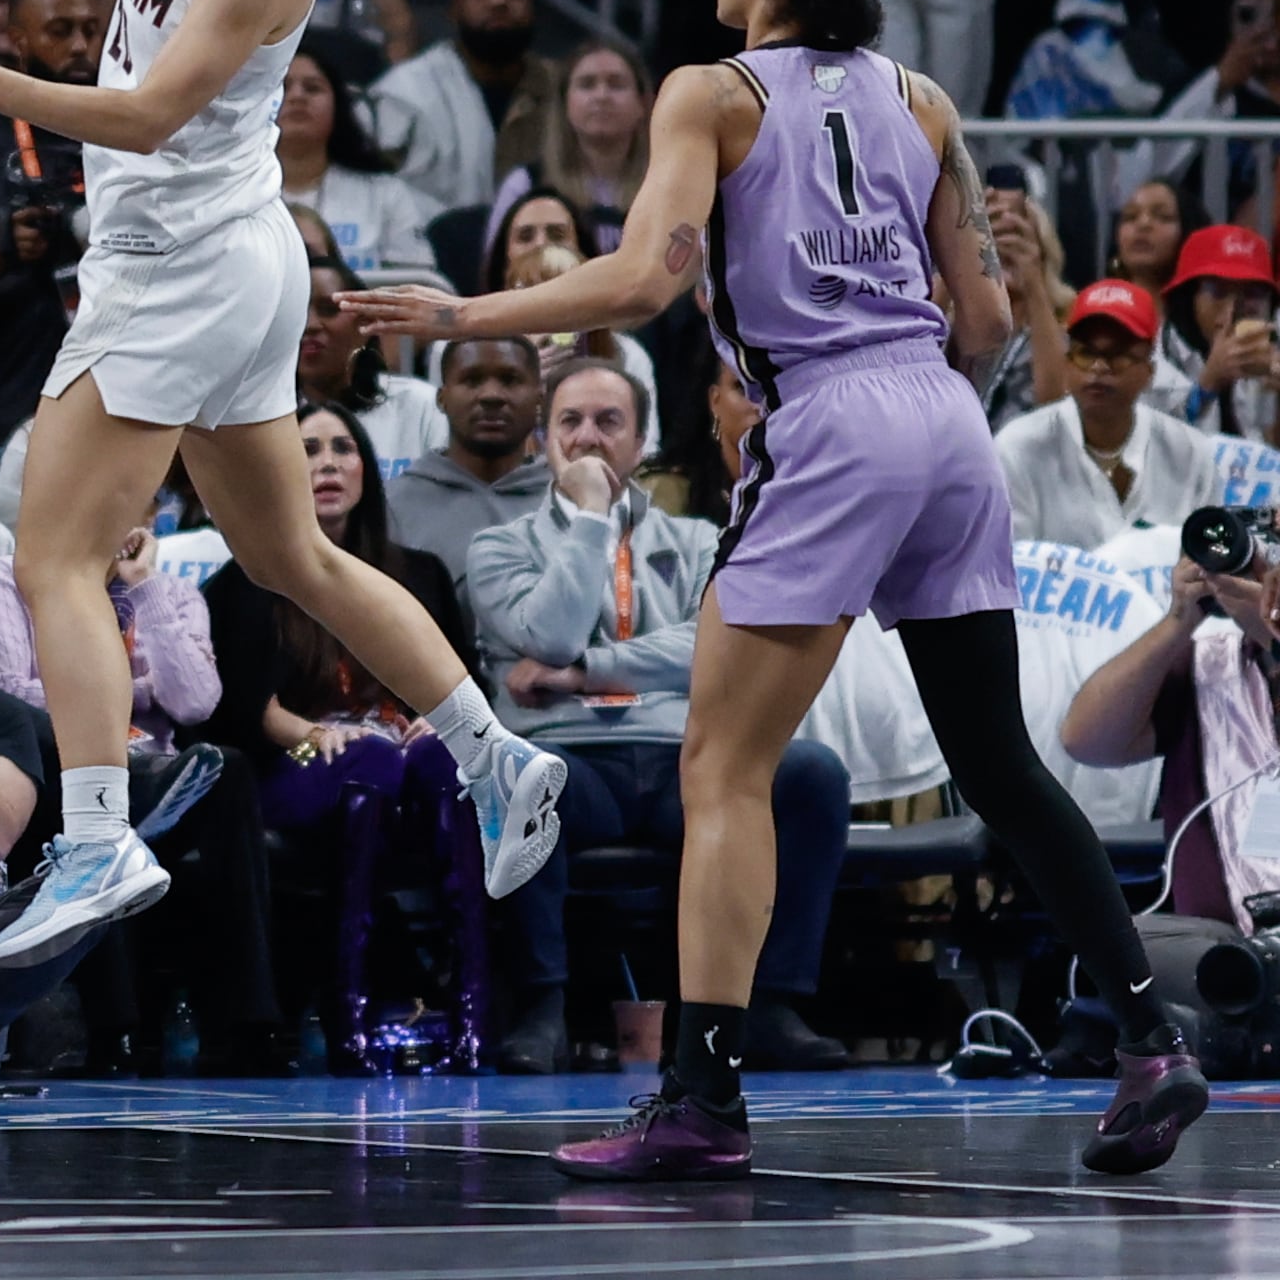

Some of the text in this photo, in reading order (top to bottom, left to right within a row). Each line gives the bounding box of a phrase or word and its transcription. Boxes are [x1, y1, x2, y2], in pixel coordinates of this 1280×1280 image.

[822, 109, 862, 218] 1
[801, 225, 901, 267] WILLIAMS
[1015, 565, 1133, 633] REAM
